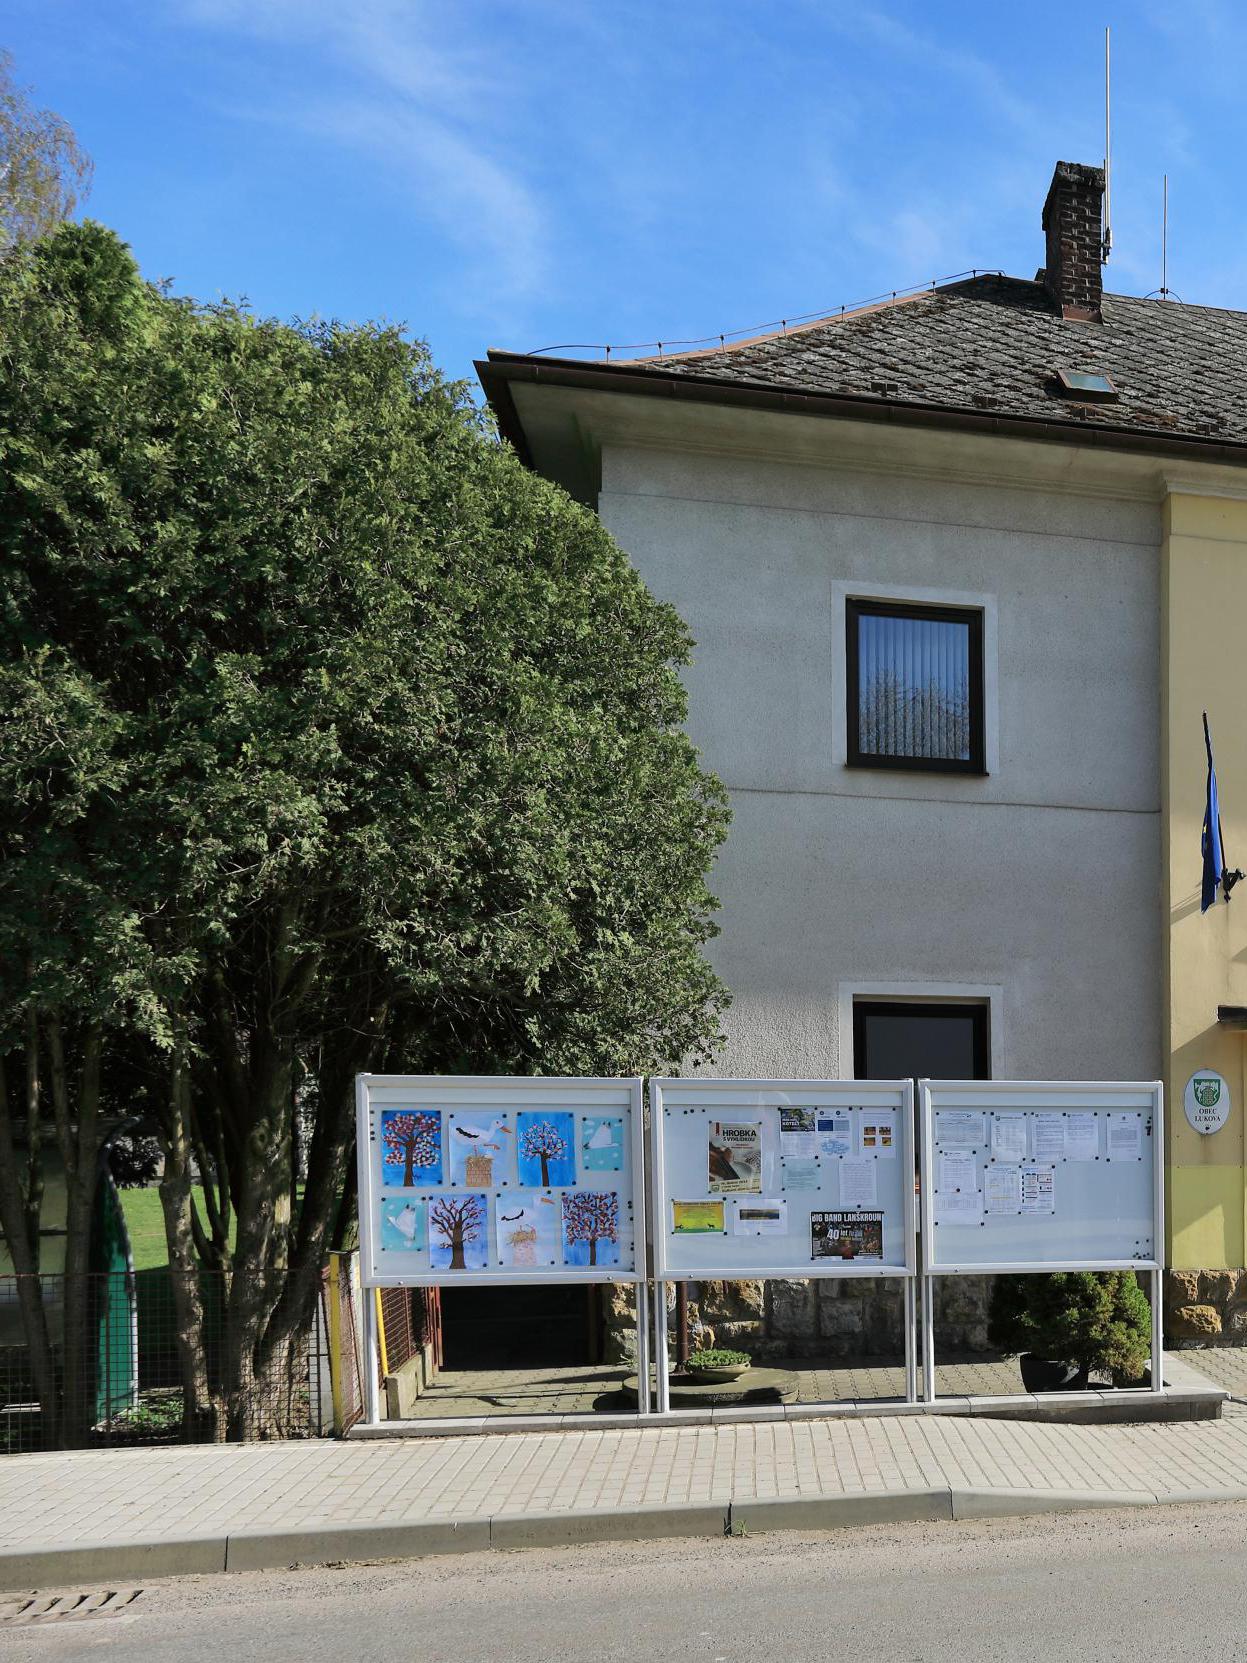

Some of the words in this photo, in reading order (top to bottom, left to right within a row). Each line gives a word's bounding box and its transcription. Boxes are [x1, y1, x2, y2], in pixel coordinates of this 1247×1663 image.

[722, 1129, 757, 1137] HROBKA
[824, 1213, 842, 1222] BAND
[827, 1229, 840, 1240] 40
